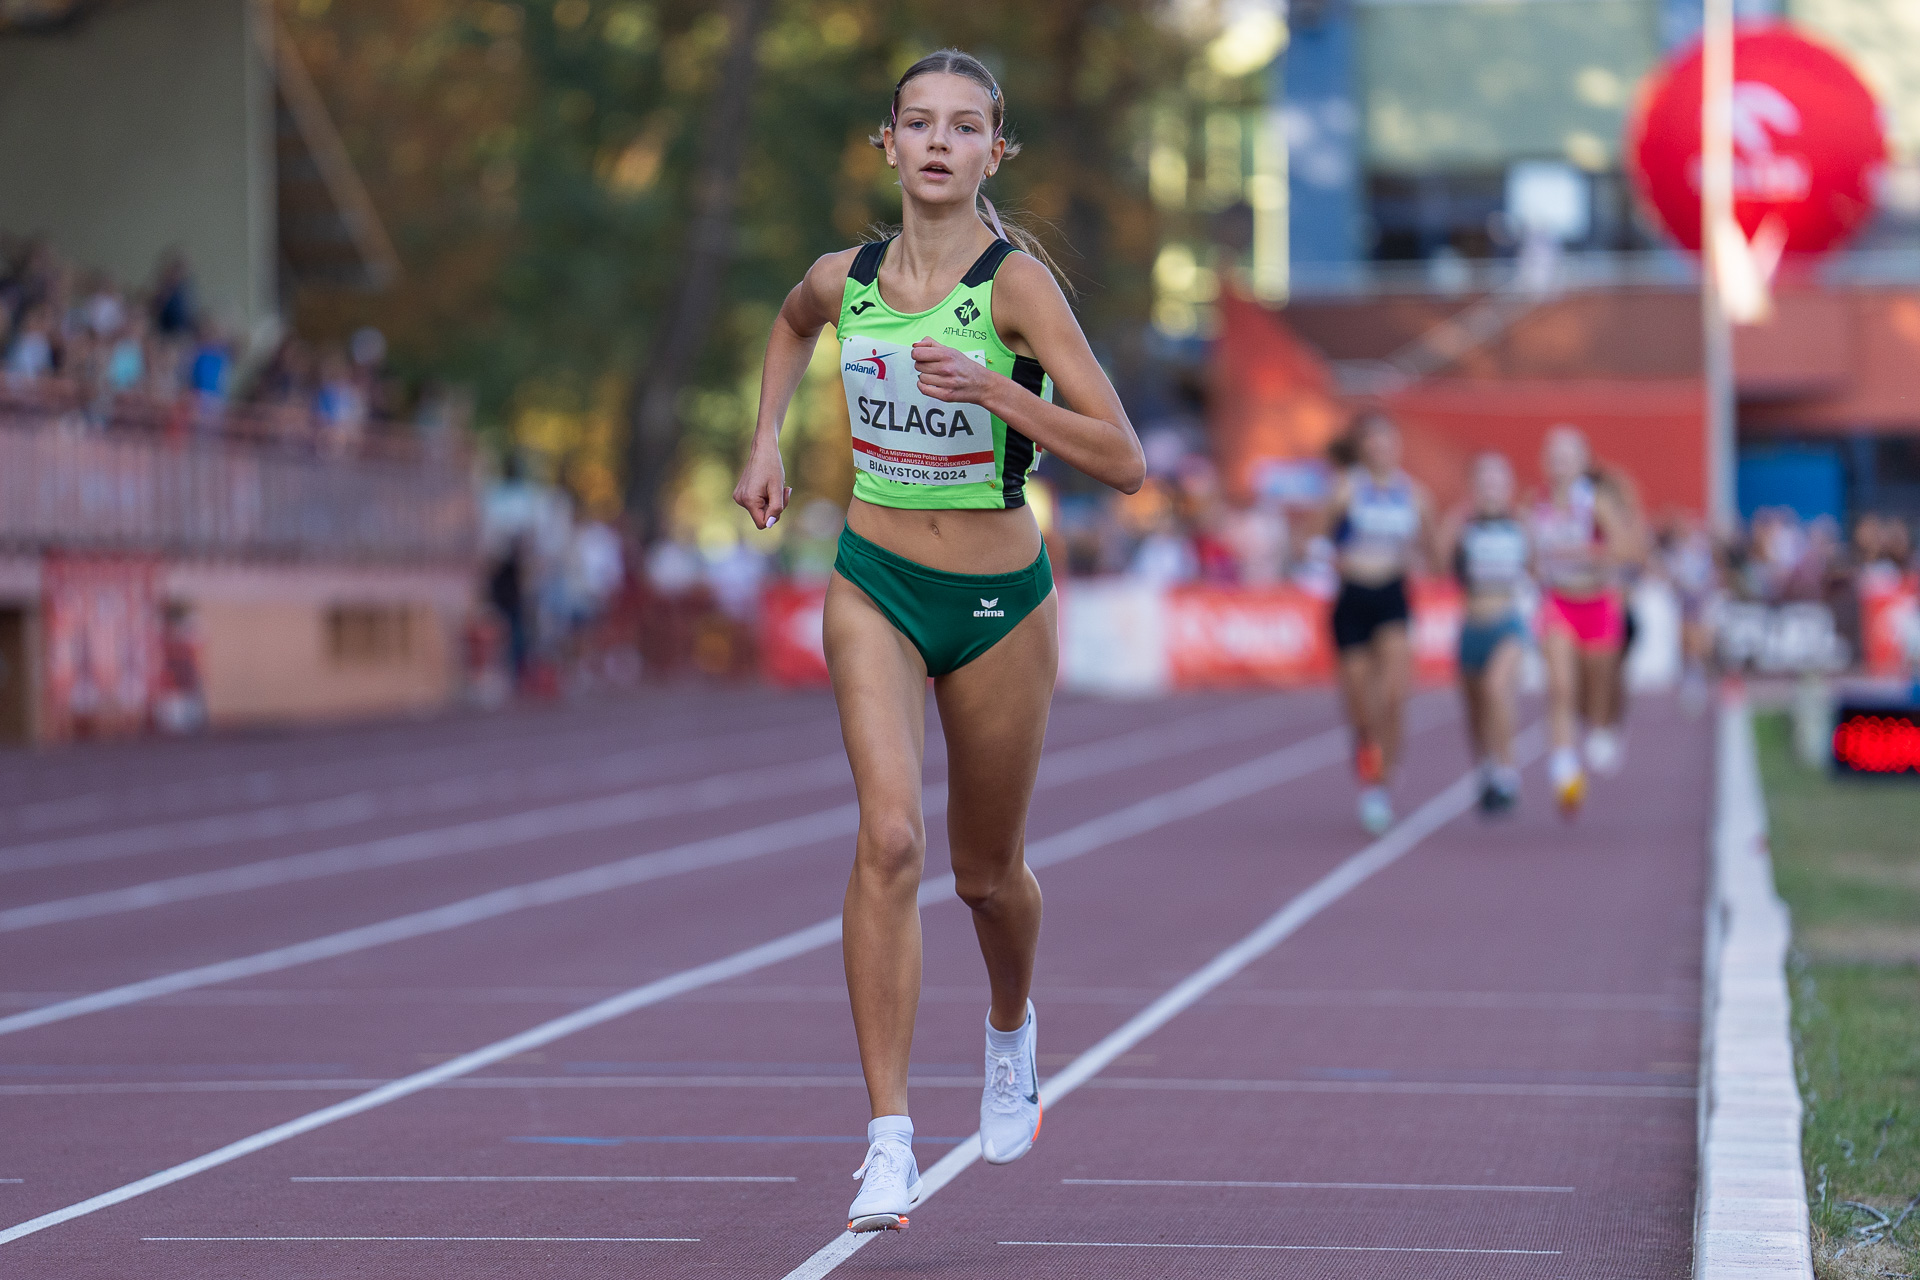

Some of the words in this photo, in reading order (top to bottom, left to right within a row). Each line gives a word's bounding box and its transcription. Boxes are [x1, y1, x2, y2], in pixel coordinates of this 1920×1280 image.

[942, 327, 987, 340] ATHLETICS
[844, 362, 876, 376] polanik
[858, 396, 974, 438] SZLAGA
[890, 450, 921, 459] Mistrzostwa
[922, 453, 937, 461] Polski
[869, 460, 930, 480] BIAŁYSTOK
[933, 470, 967, 481] 2024
[973, 609, 1005, 618] erima
